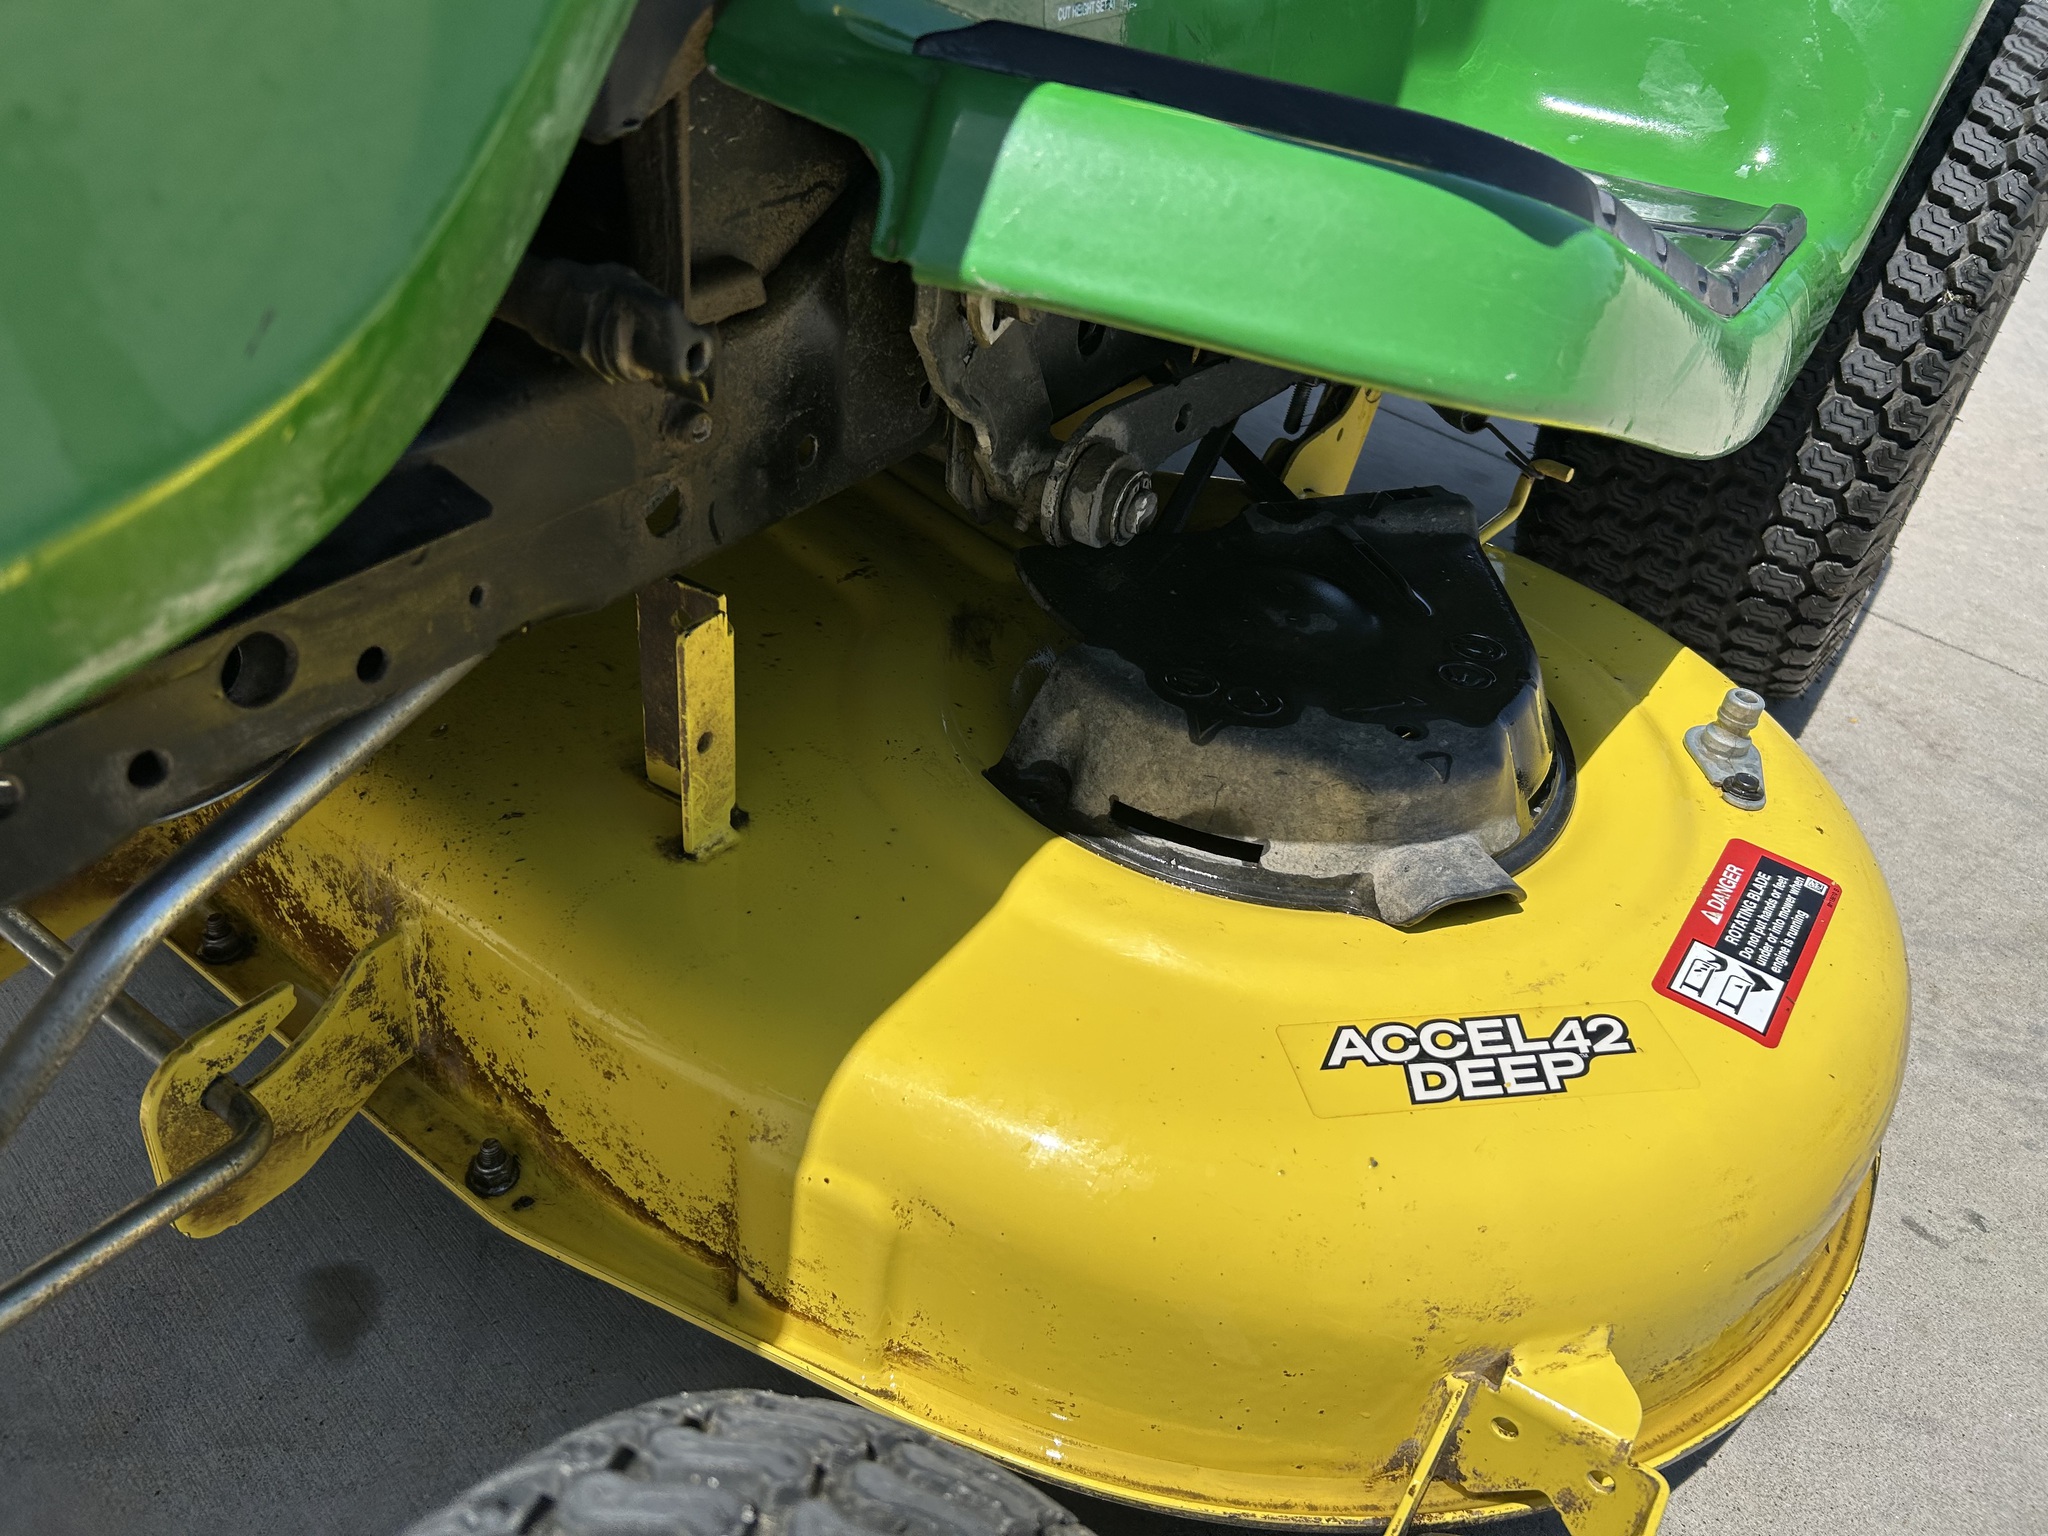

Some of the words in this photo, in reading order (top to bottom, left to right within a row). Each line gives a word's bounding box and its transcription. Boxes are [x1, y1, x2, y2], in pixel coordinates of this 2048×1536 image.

[1057, 6, 1071, 21] CUT
[1707, 864, 1744, 911] DANGER
[1773, 875, 1789, 893] feet
[1789, 876, 1806, 899] when
[1772, 889, 1782, 899] or
[1724, 899, 1757, 946] ROTATING
[1747, 871, 1772, 902] BLADE
[1761, 898, 1778, 921] hands
[1779, 894, 1796, 920] mower
[1756, 918, 1768, 936] put
[1769, 917, 1783, 935] into
[1787, 909, 1809, 940] running
[1750, 931, 1761, 946] not
[1767, 932, 1779, 944] or
[1780, 938, 1794, 947] is
[1739, 946, 1752, 960] Do
[1756, 942, 1773, 966] under
[1771, 945, 1790, 973] engine
